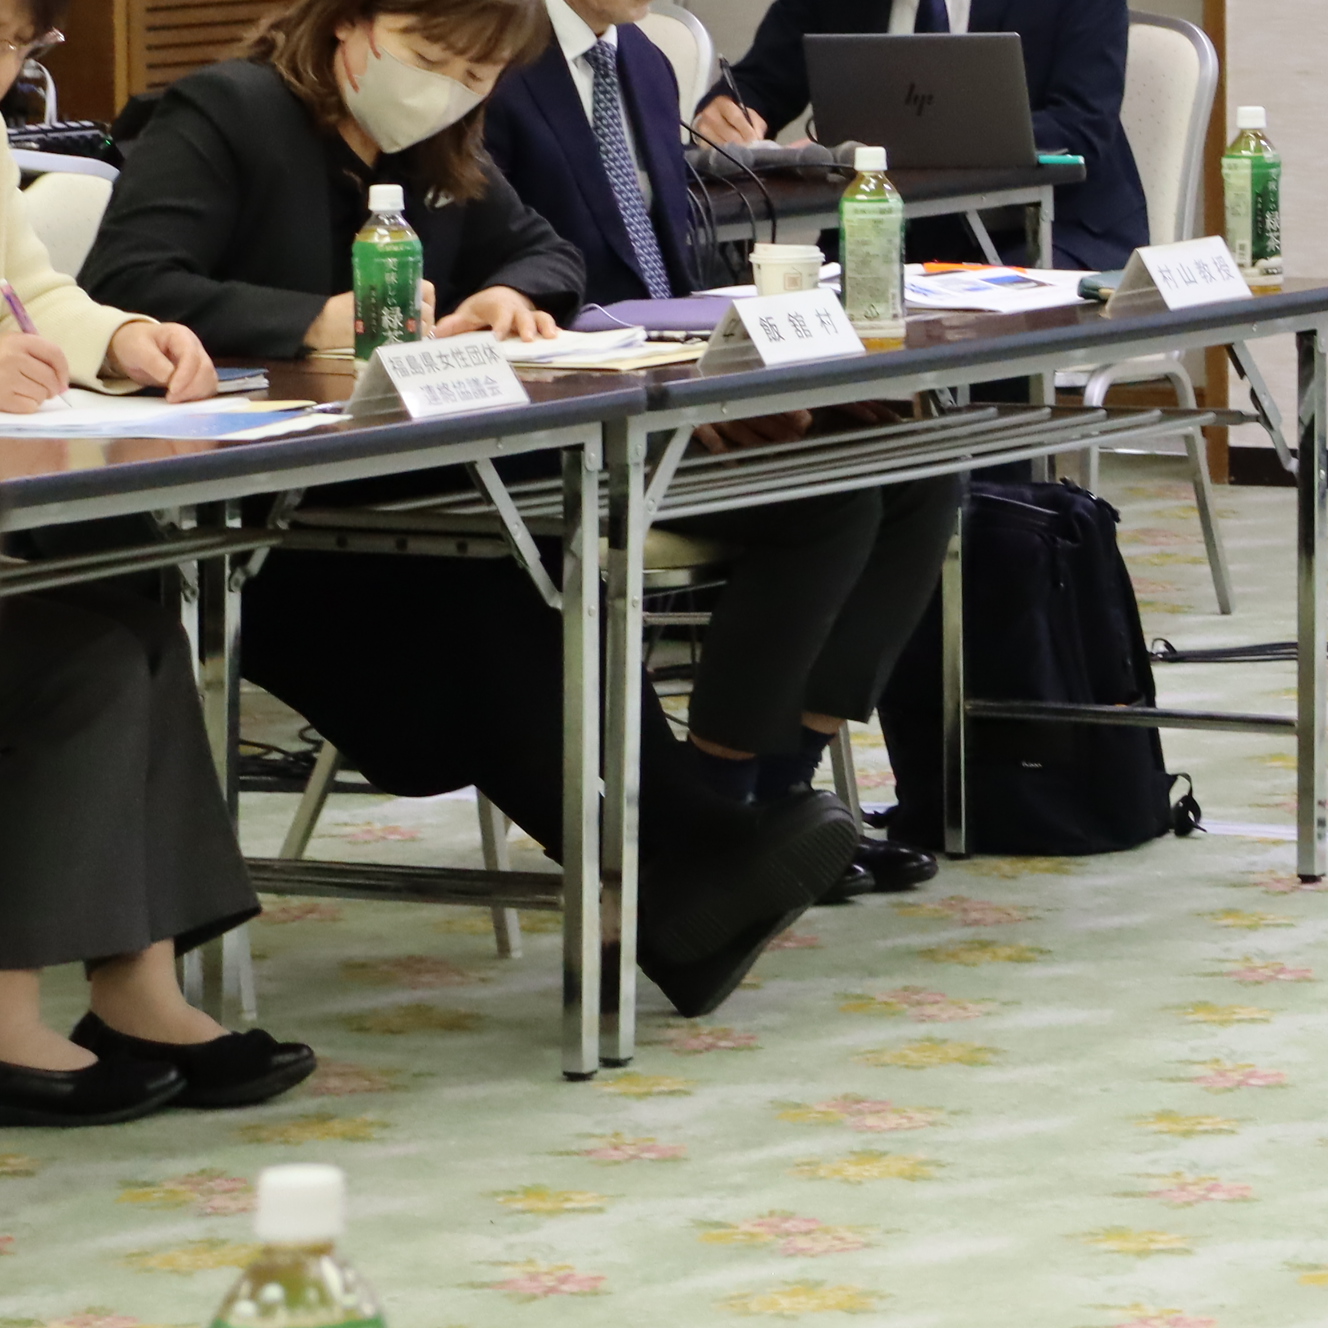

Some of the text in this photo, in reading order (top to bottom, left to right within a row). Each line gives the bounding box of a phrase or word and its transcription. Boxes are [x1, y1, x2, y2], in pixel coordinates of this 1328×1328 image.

[1157, 255, 1235, 291] 村山教授
[388, 342, 502, 379] 福島県女性団体
[419, 375, 503, 406] 連絡協議会
